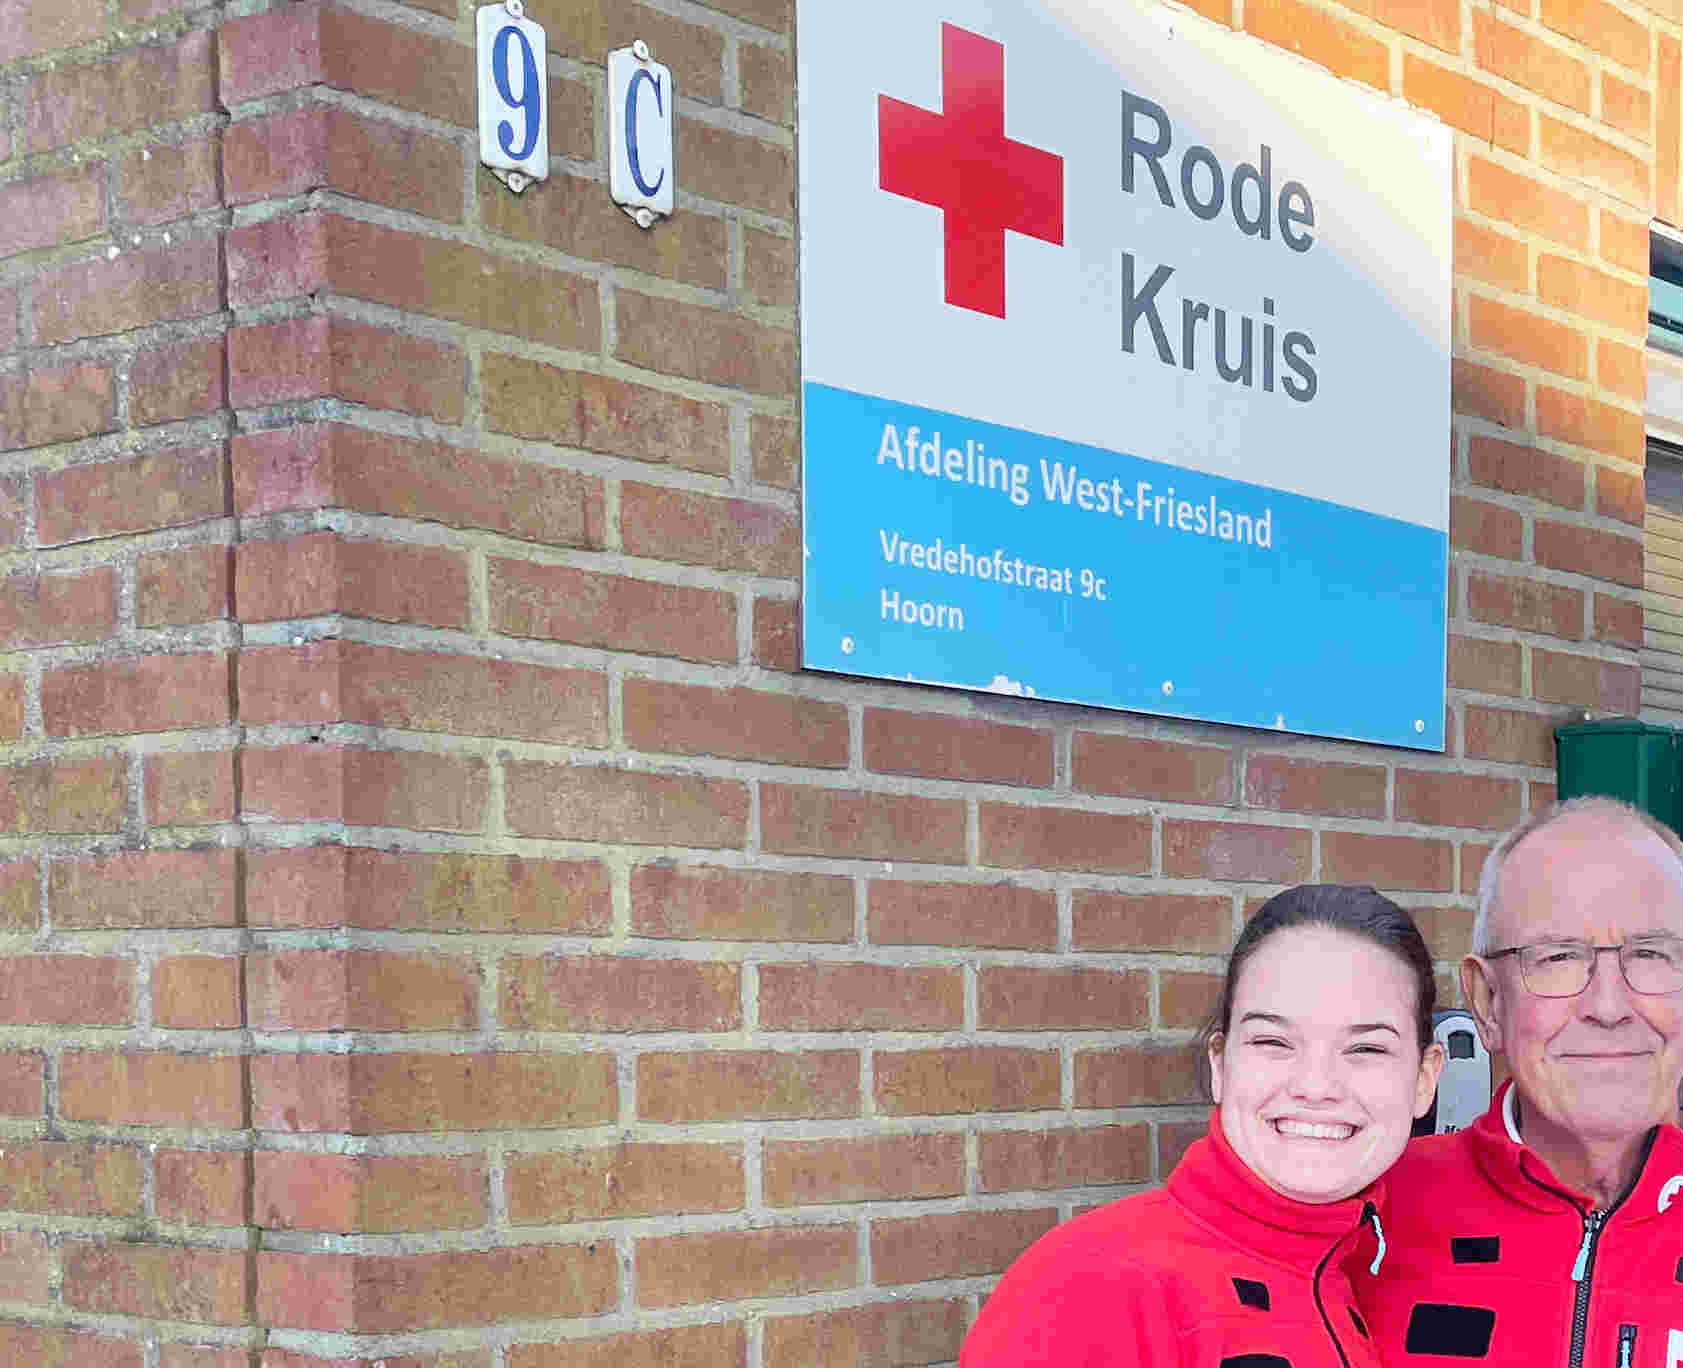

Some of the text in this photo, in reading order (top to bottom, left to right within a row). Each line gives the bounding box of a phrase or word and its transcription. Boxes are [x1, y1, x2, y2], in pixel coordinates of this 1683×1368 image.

[492, 24, 665, 198] 9 C
[1120, 89, 1315, 254] Rode
[1120, 251, 1318, 403] Kruis
[876, 423, 1272, 549] Afdeling West-Friesland
[879, 529, 1106, 601] Vredehofstraat 9c
[881, 589, 964, 631] Hoorn
